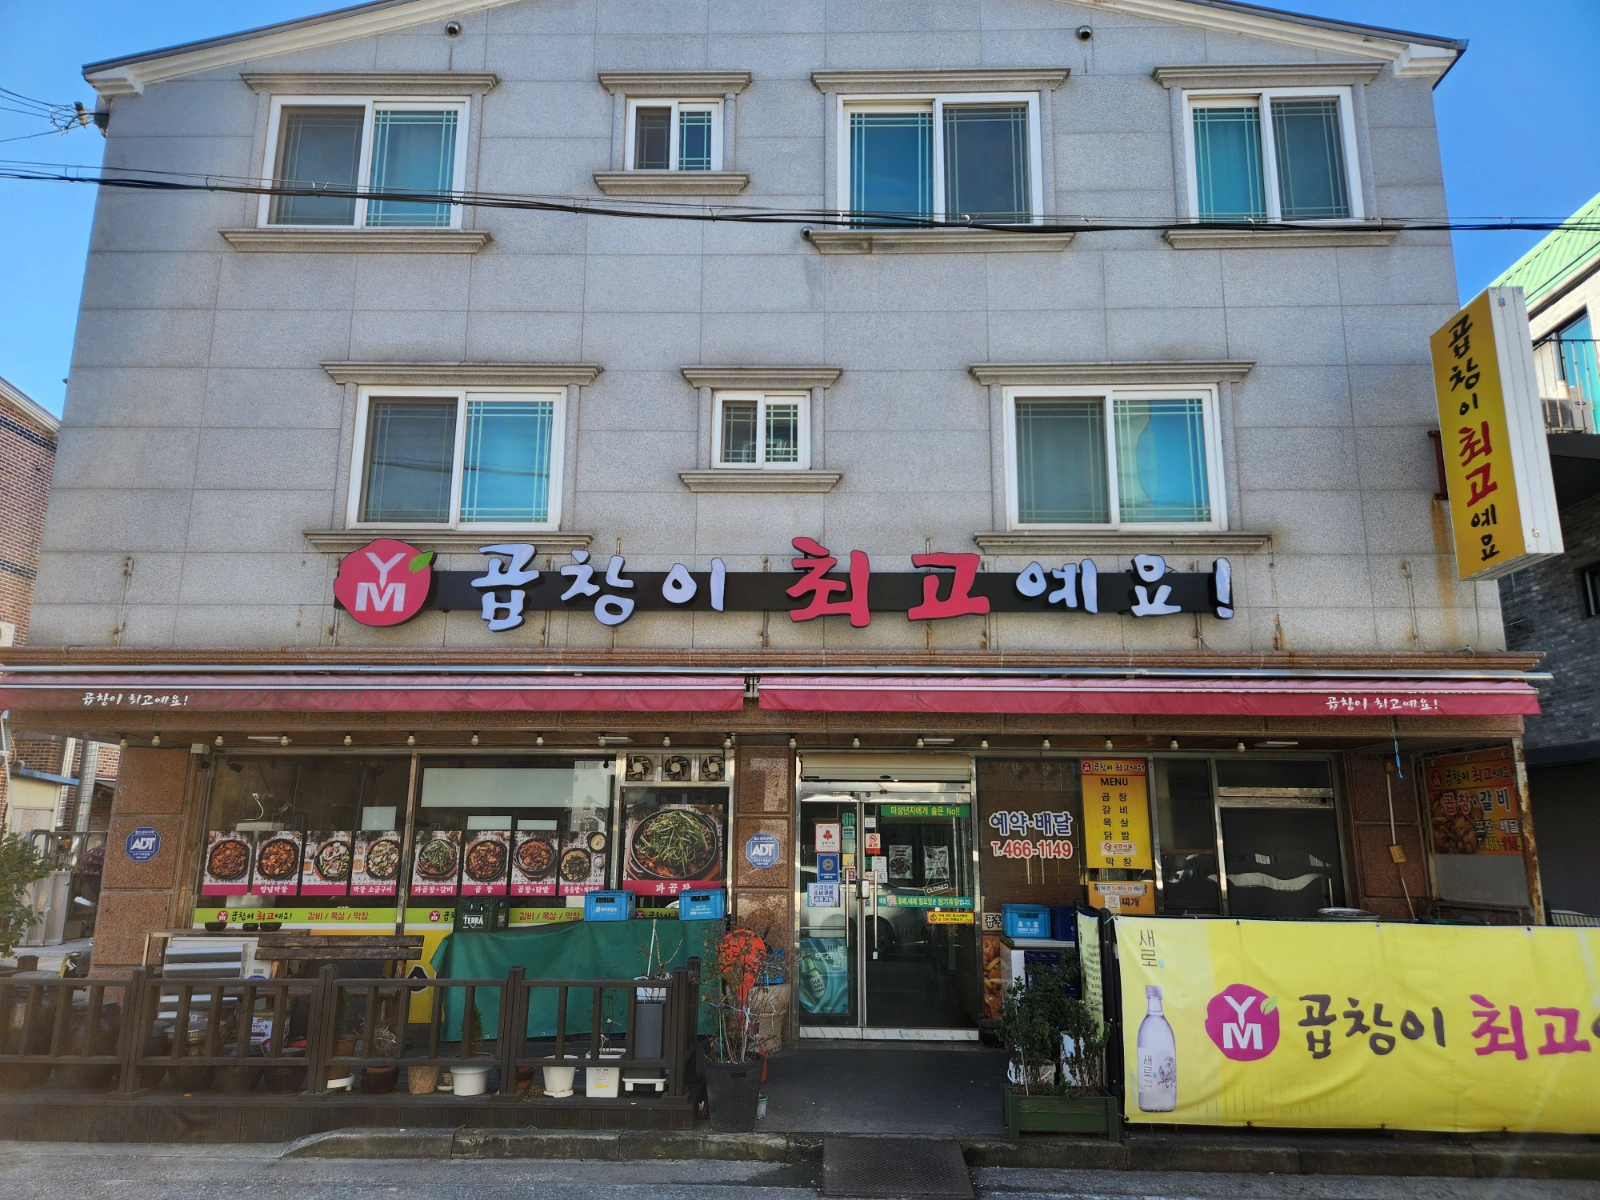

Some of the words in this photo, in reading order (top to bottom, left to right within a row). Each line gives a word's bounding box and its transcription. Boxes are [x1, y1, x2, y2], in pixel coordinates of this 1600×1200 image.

[1447, 312, 1481, 416] 곱창이
[1457, 420, 1500, 562] 최고예요
[470, 543, 726, 632] 곱창이
[785, 536, 1235, 628] 최고예요!
[82, 692, 123, 707] 곱창이
[1325, 695, 1367, 711] 곱창이
[1100, 777, 1129, 787] MENU
[890, 805, 929, 816] 미성년자에게
[931, 806, 944, 816] 술은
[131, 838, 156, 850] ADT
[751, 844, 775, 856] ADT
[926, 883, 949, 895] CLOSED
[231, 911, 254, 922] 곱창이
[307, 912, 323, 921] 갈비
[331, 912, 345, 921] 목살
[354, 912, 369, 921] 막창
[462, 914, 484, 925] TERRA
[519, 912, 534, 921] 갈비
[542, 912, 557, 921] 목살
[565, 912, 581, 921] 막창
[1297, 993, 1446, 1060] 곱창이
